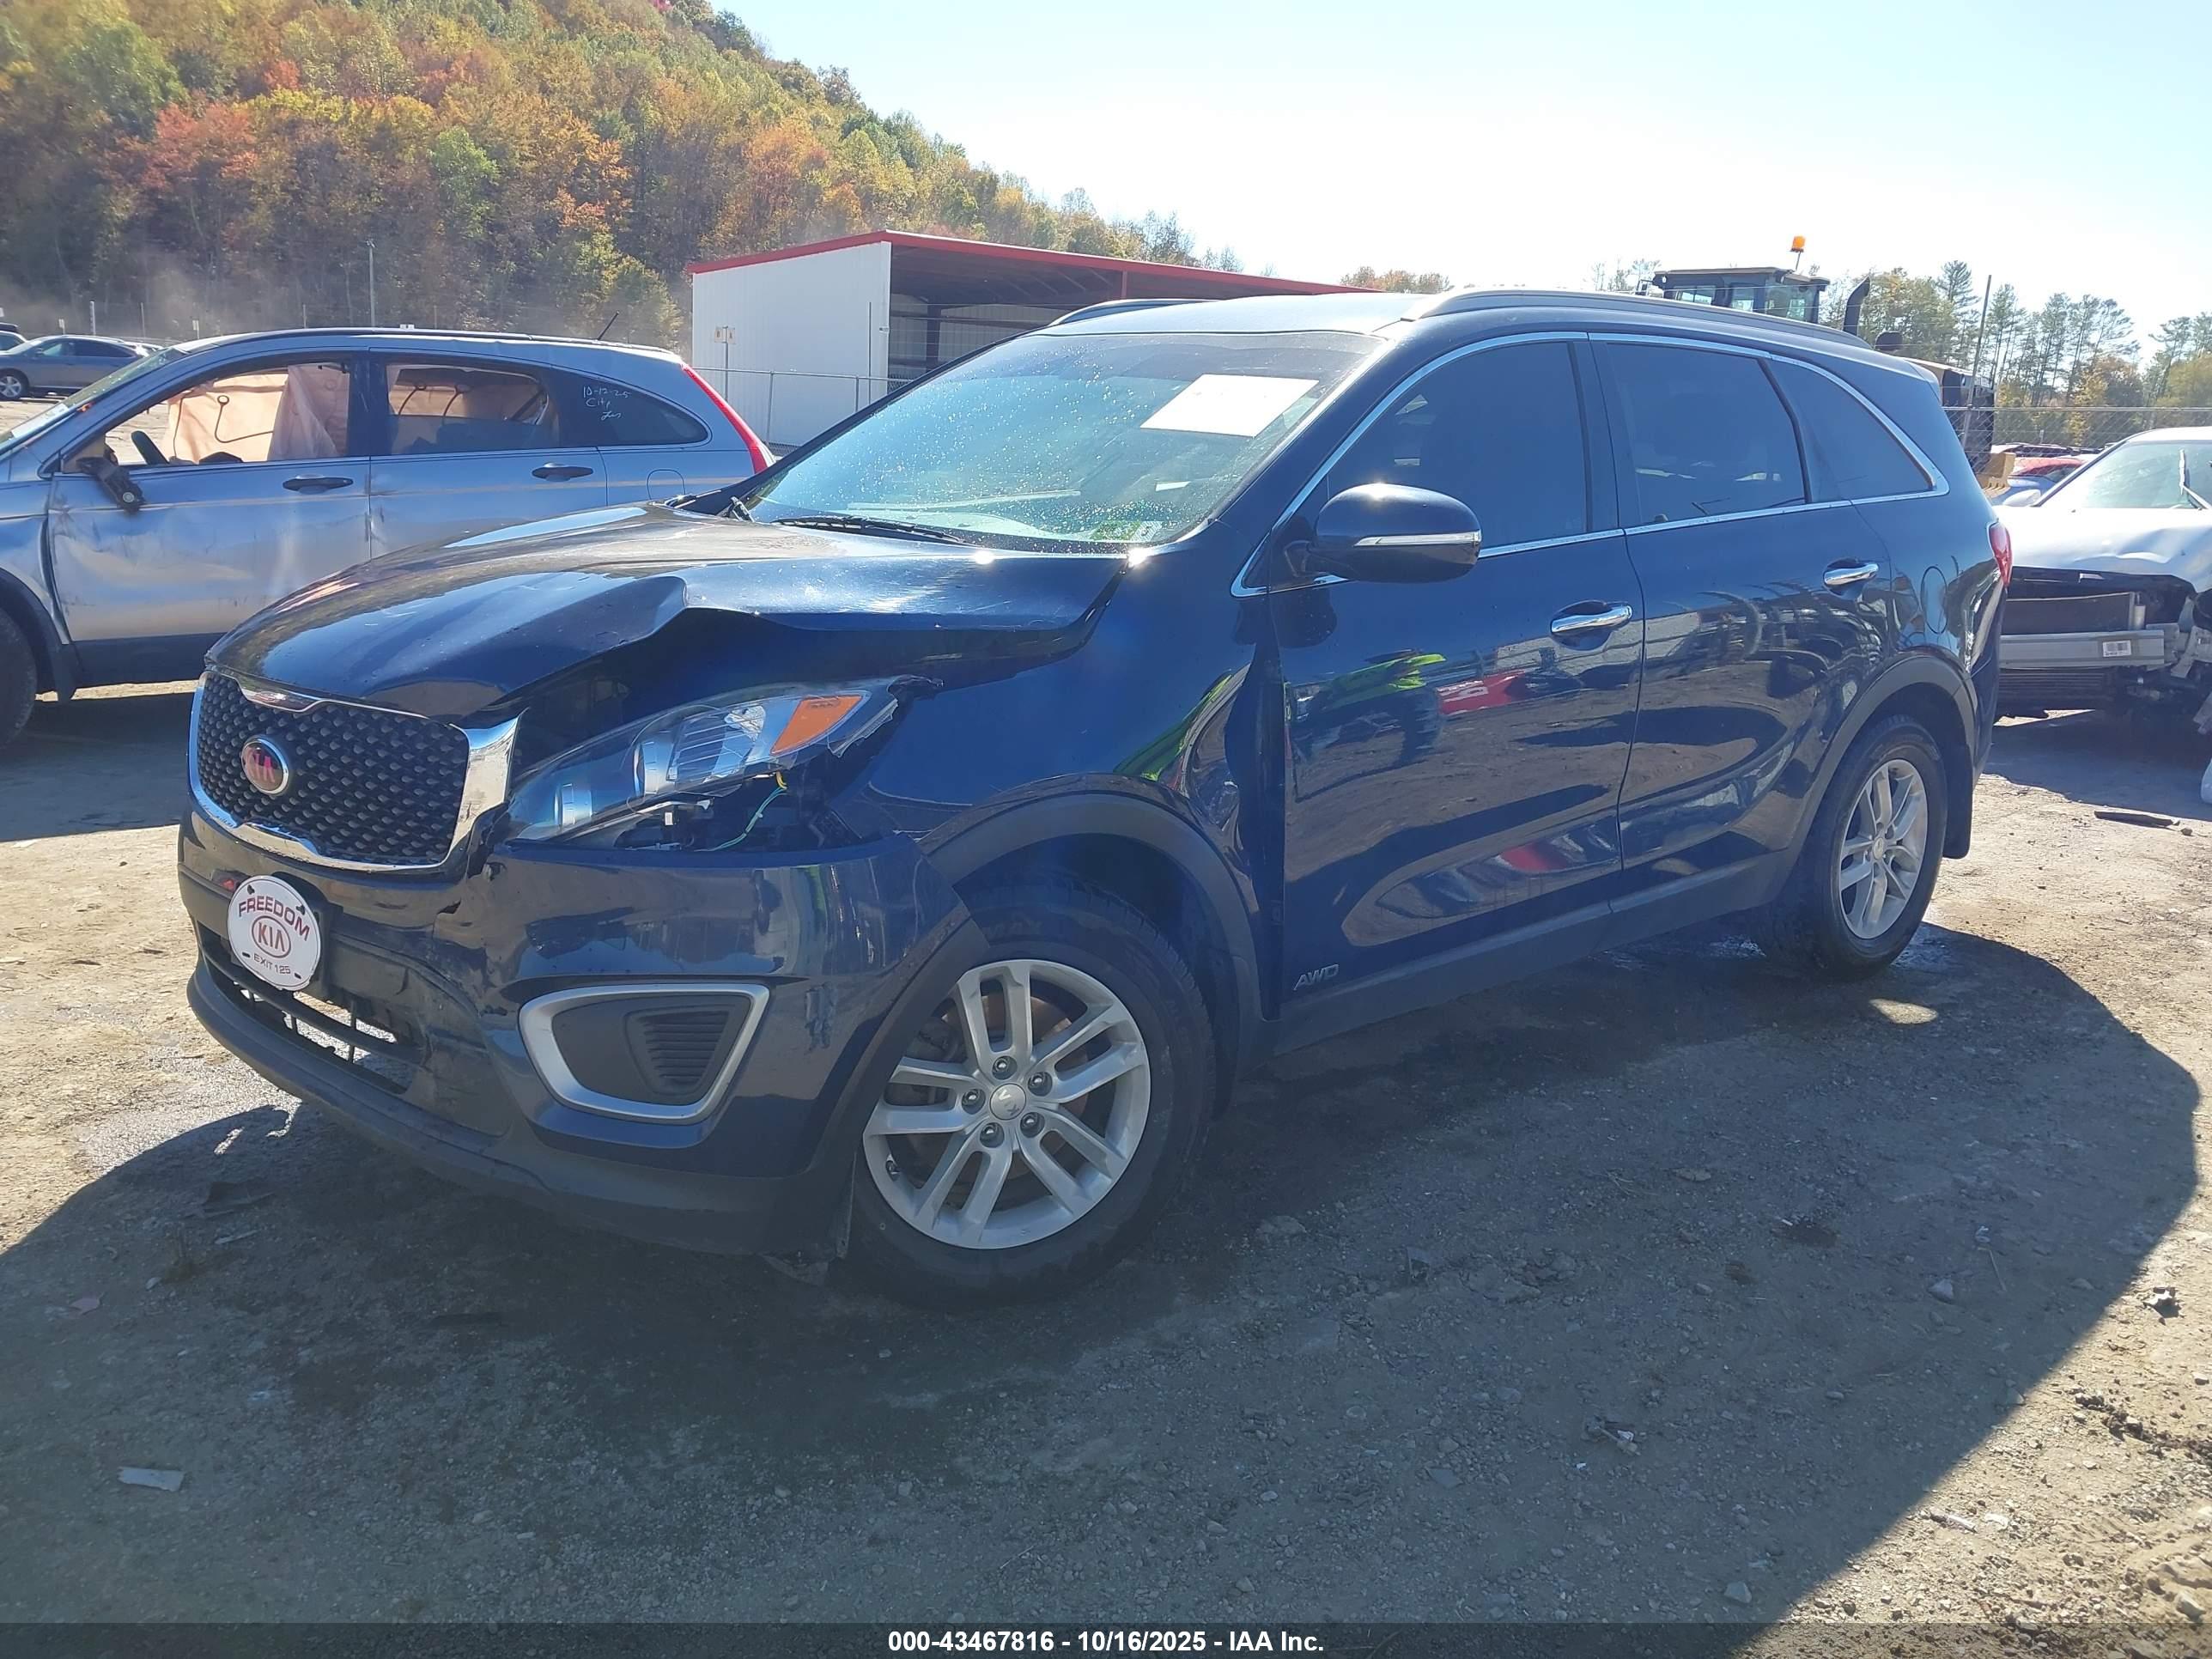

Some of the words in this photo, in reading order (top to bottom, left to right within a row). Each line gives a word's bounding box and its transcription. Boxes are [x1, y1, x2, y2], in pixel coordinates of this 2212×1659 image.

[238, 896, 311, 942] FREEDOM
[258, 921, 286, 952] KIA
[253, 953, 273, 970] EXIT
[274, 964, 291, 975] 125
[1293, 963, 1340, 991] AWD
